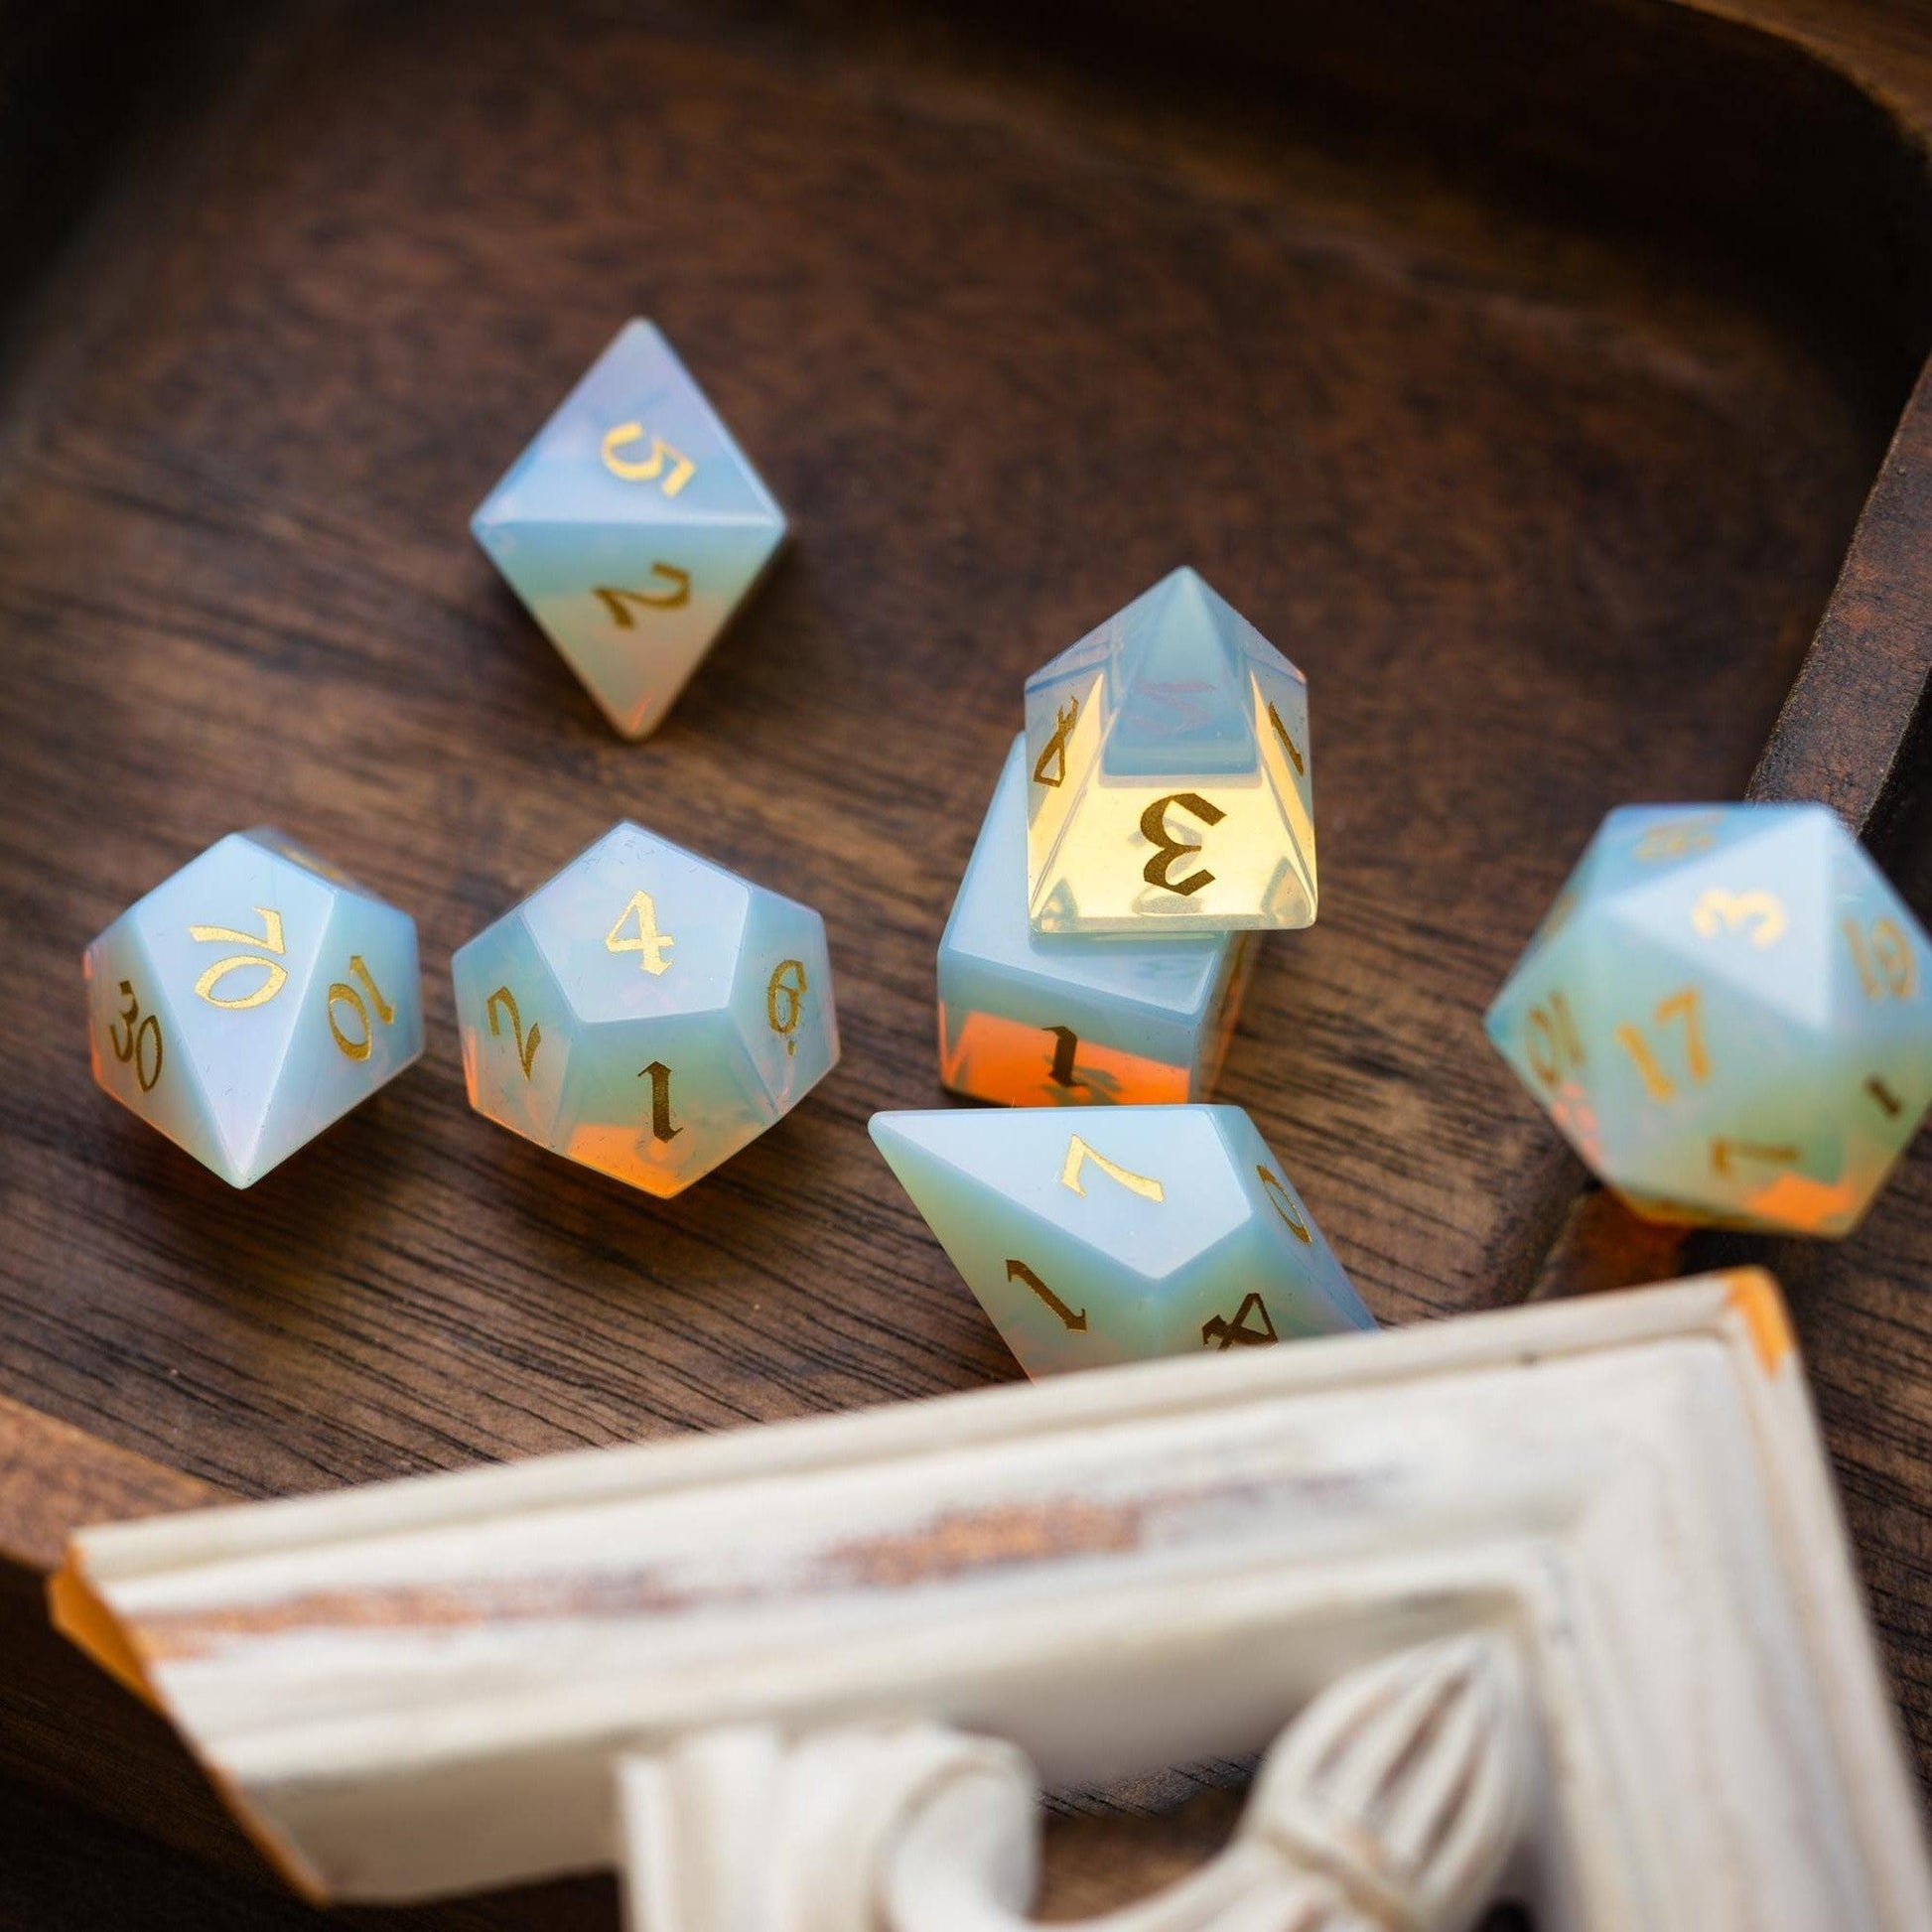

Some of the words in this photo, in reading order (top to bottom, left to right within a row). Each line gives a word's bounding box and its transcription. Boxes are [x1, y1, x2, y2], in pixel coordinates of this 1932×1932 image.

[602, 422, 695, 498] 5
[592, 562, 691, 629] 2
[1140, 792, 1228, 897] 3
[189, 905, 289, 1011] 70
[605, 890, 675, 977] 4
[1694, 889, 1786, 950] 3
[1844, 917, 1916, 1001] 19
[110, 981, 163, 1093] 30
[486, 986, 542, 1082] 2
[1041, 1025, 1078, 1087] 1
[1615, 987, 1711, 1097] 17
[637, 1060, 683, 1144] 1
[1060, 1133, 1166, 1204] 7
[1005, 1259, 1088, 1334] 1
